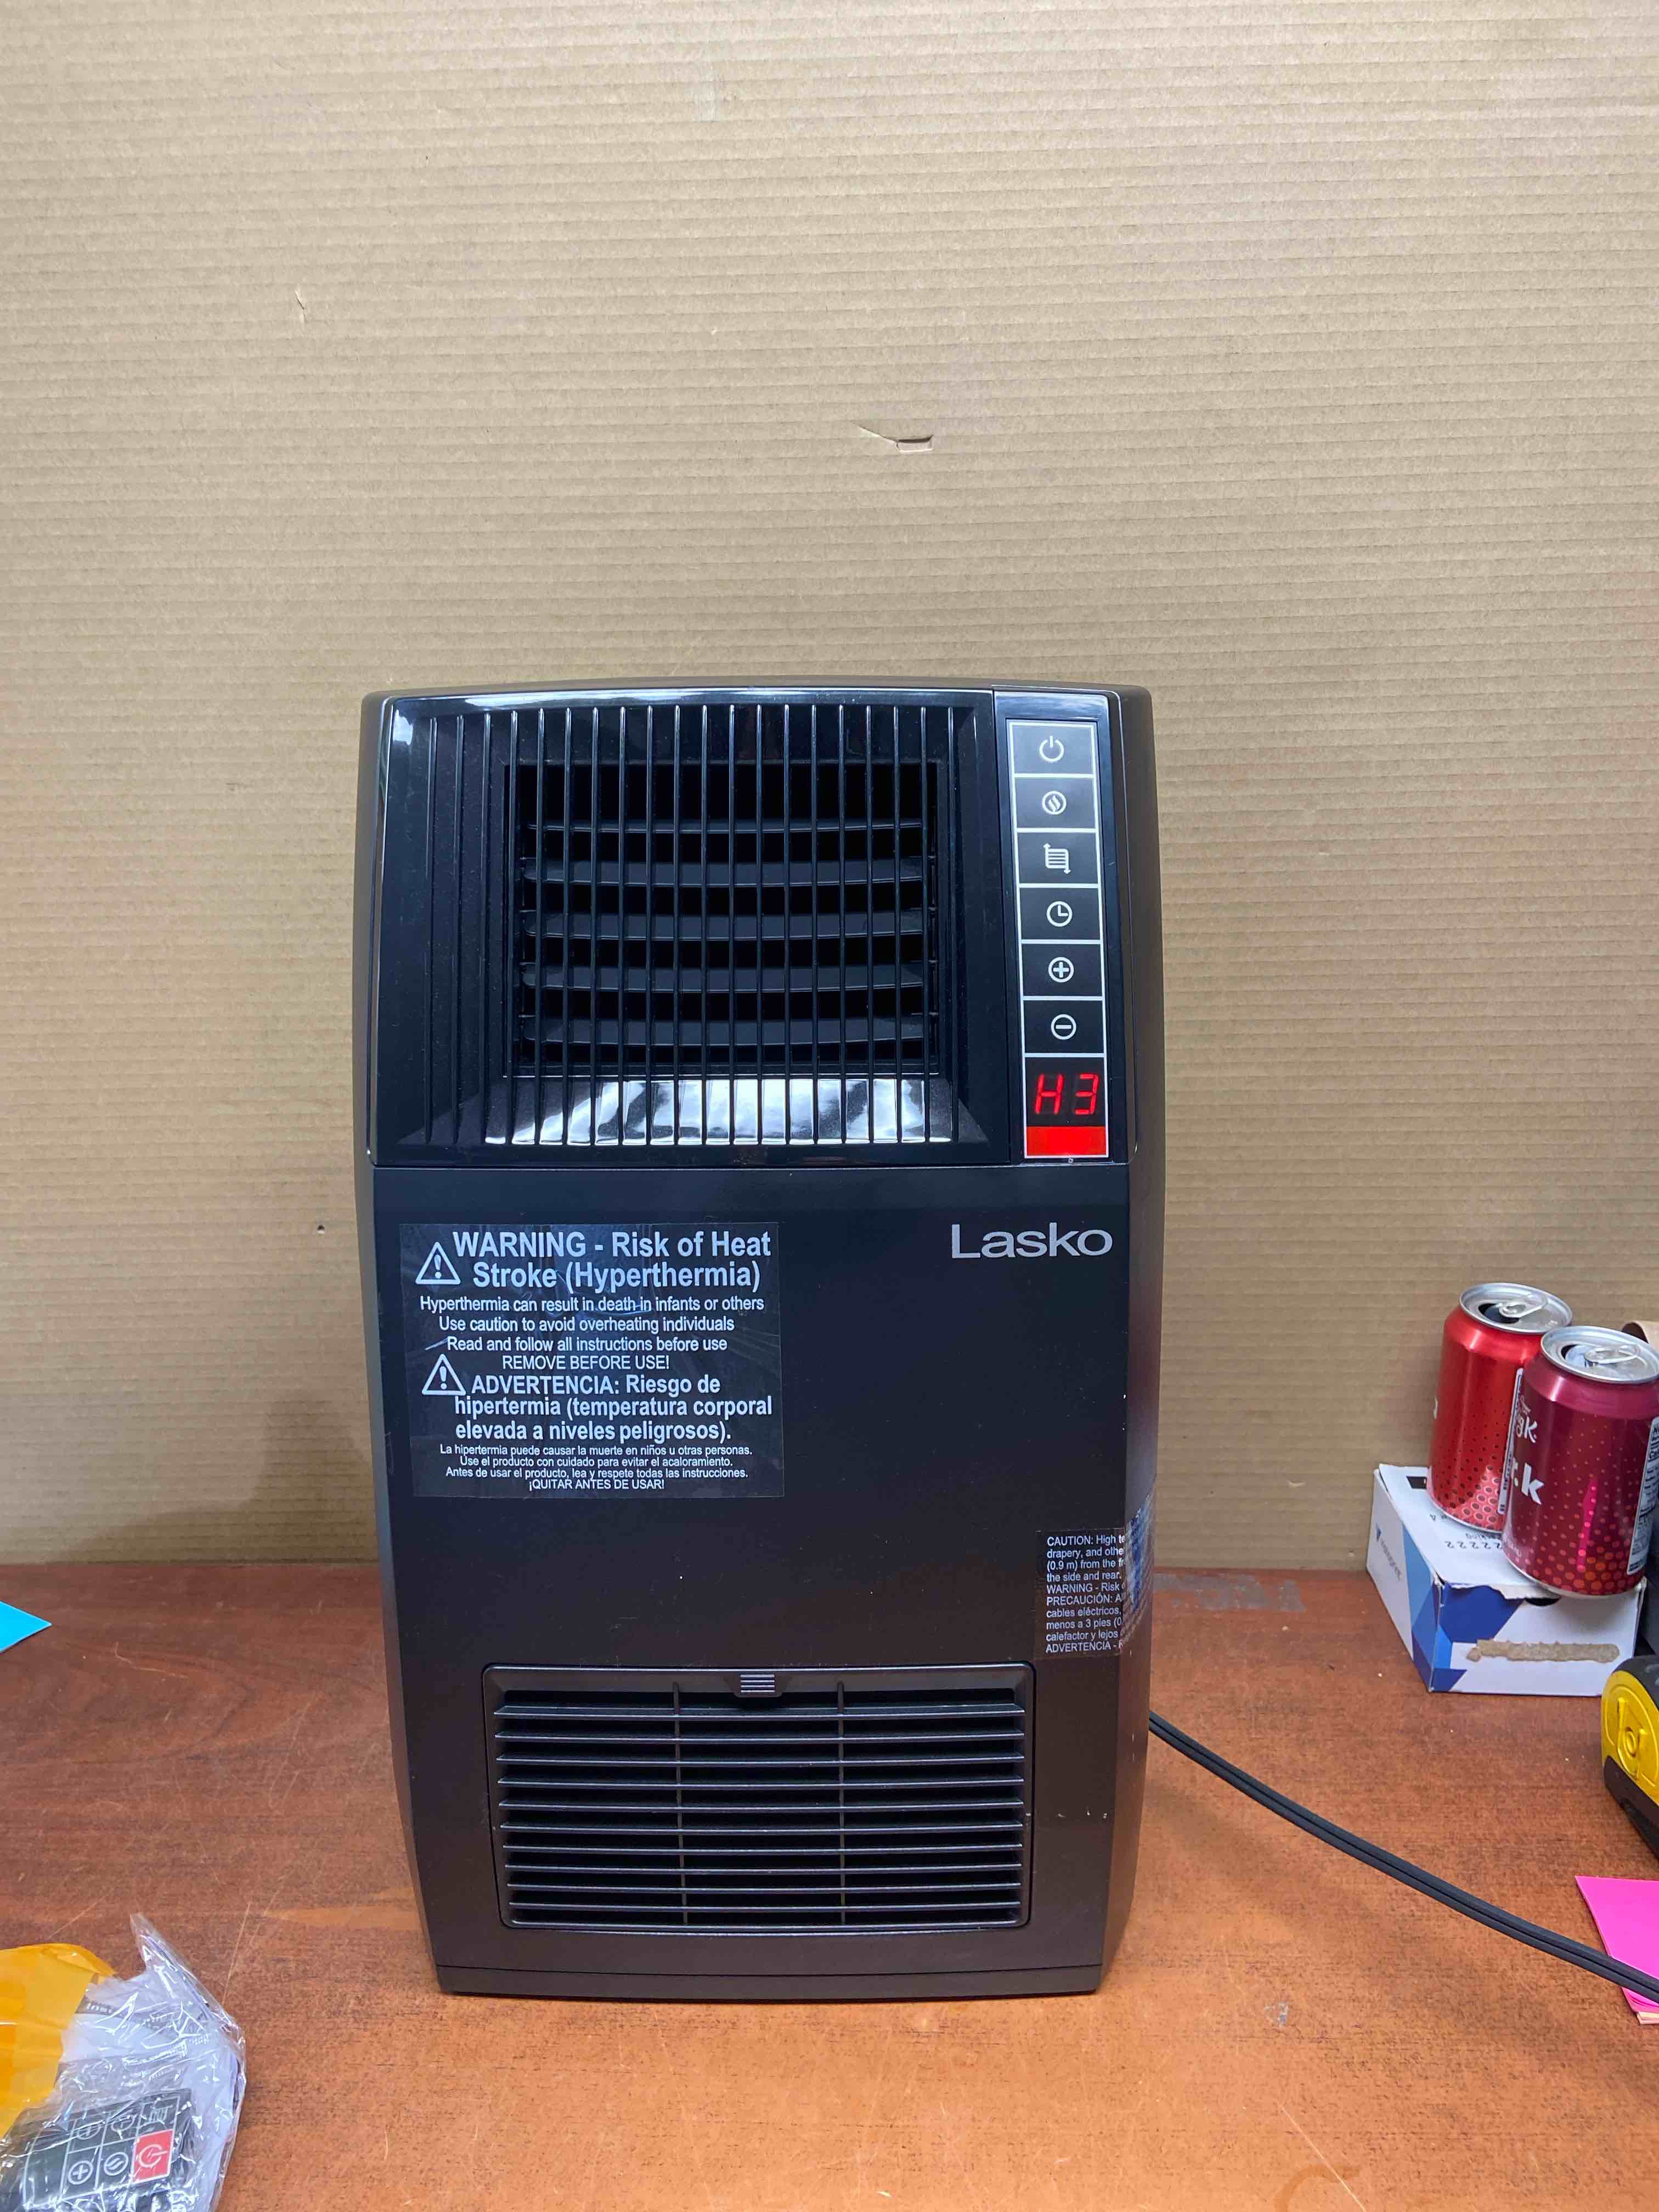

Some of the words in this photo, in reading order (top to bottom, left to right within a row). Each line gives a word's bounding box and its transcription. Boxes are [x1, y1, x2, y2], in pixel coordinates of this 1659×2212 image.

[1034, 1072, 1101, 1115] H3
[453, 1232, 586, 1257] WARNING
[612, 1231, 670, 1257] Risk
[677, 1231, 704, 1257] of
[712, 1231, 771, 1256] Heat
[951, 1222, 1113, 1259] Lasko
[473, 1261, 557, 1288] Stroke
[566, 1260, 760, 1294] (Hyperthermia)
[420, 1296, 510, 1313] Hyperthermia
[514, 1299, 537, 1312] can
[542, 1297, 579, 1312] result
[583, 1297, 594, 1311] in
[598, 1296, 636, 1311] death
[640, 1296, 652, 1311] in
[656, 1296, 701, 1311] infants
[704, 1299, 719, 1310] or
[721, 1295, 765, 1310] others
[439, 1316, 466, 1331] Use
[470, 1317, 518, 1331] caution
[522, 1317, 535, 1331] to
[539, 1316, 575, 1331] avoid
[579, 1316, 659, 1334] overheating
[663, 1316, 735, 1331] individuals
[447, 1336, 483, 1351] Read
[486, 1336, 512, 1351] and
[515, 1336, 554, 1351] follow
[557, 1336, 573, 1351] all
[576, 1337, 653, 1351] instructions
[656, 1336, 699, 1351] before
[703, 1339, 728, 1351] use
[503, 1355, 566, 1370] REMOVE
[570, 1355, 631, 1369] BEFORE
[635, 1355, 670, 1369] USE!
[471, 1375, 619, 1395] ADVERTENCIA:
[626, 1374, 692, 1397] Riesgo
[697, 1374, 721, 1393] de
[454, 1395, 561, 1419] hipertermia
[567, 1397, 688, 1421] (temperatura
[693, 1395, 772, 1420] corporal
[455, 1420, 527, 1440] elevada
[532, 1424, 544, 1440] a
[549, 1420, 616, 1440] niveles
[619, 1420, 731, 1444] peligrosos).
[440, 1443, 453, 1454] La
[454, 1444, 508, 1457] hipertermia
[510, 1445, 540, 1457] puede
[543, 1446, 576, 1455] causar
[578, 1445, 586, 1455] la
[589, 1446, 623, 1455] muerte
[625, 1447, 637, 1455] en
[640, 1444, 667, 1455] niños
[669, 1447, 676, 1455] u
[678, 1446, 703, 1455] otras
[705, 1446, 753, 1457] personas.
[460, 1456, 479, 1466] Use
[481, 1456, 490, 1466] el
[493, 1456, 534, 1468] producto
[537, 1458, 555, 1466] con
[556, 1457, 595, 1467] cuidado
[597, 1458, 619, 1468] para
[622, 1457, 649, 1466] evitar
[651, 1457, 660, 1466] el
[662, 1457, 733, 1466] acaloramiento.
[445, 1467, 473, 1477] Antes
[476, 1467, 488, 1477] de
[490, 1469, 512, 1477] usar
[514, 1468, 523, 1477] el
[524, 1468, 569, 1480] producto,
[572, 1468, 587, 1478] lea
[589, 1470, 596, 1481] y
[597, 1469, 634, 1481] respete
[636, 1468, 663, 1478] todas
[665, 1468, 680, 1478] las
[682, 1468, 749, 1478] instrucciones.
[528, 1479, 573, 1491] ¡QUITAR
[575, 1479, 611, 1489] ANTES
[613, 1479, 629, 1489] DE
[631, 1479, 665, 1489] USAR!
[1047, 1535, 1094, 1547] CAUTION:
[1096, 1534, 1116, 1546] High
[1046, 1549, 1084, 1559] drapery,
[1086, 1547, 1103, 1557] and
[1046, 1560, 1064, 1572] (0.9
[1066, 1559, 1078, 1571] m)
[1080, 1560, 1100, 1569] from
[1102, 1559, 1116, 1568] the
[1046, 1573, 1060, 1583] the
[1063, 1572, 1081, 1582] side
[1083, 1571, 1100, 1581] and
[1102, 1572, 1122, 1581] rear.
[1046, 1583, 1093, 1594] WARNING
[1101, 1581, 1120, 1592] Risk
[1046, 1593, 1113, 1606] PRECAUCIÓN:
[1046, 1607, 1075, 1618] cables
[1046, 1621, 1075, 1630] menos
[1077, 1621, 1084, 1629] a
[1085, 1618, 1092, 1629] 3
[1093, 1617, 1111, 1630] pies
[1046, 1631, 1089, 1642] calefactor
[1090, 1632, 1096, 1641] y
[1098, 1629, 1119, 1641] lejos
[1045, 1640, 1111, 1654] ADVERTENCIA
